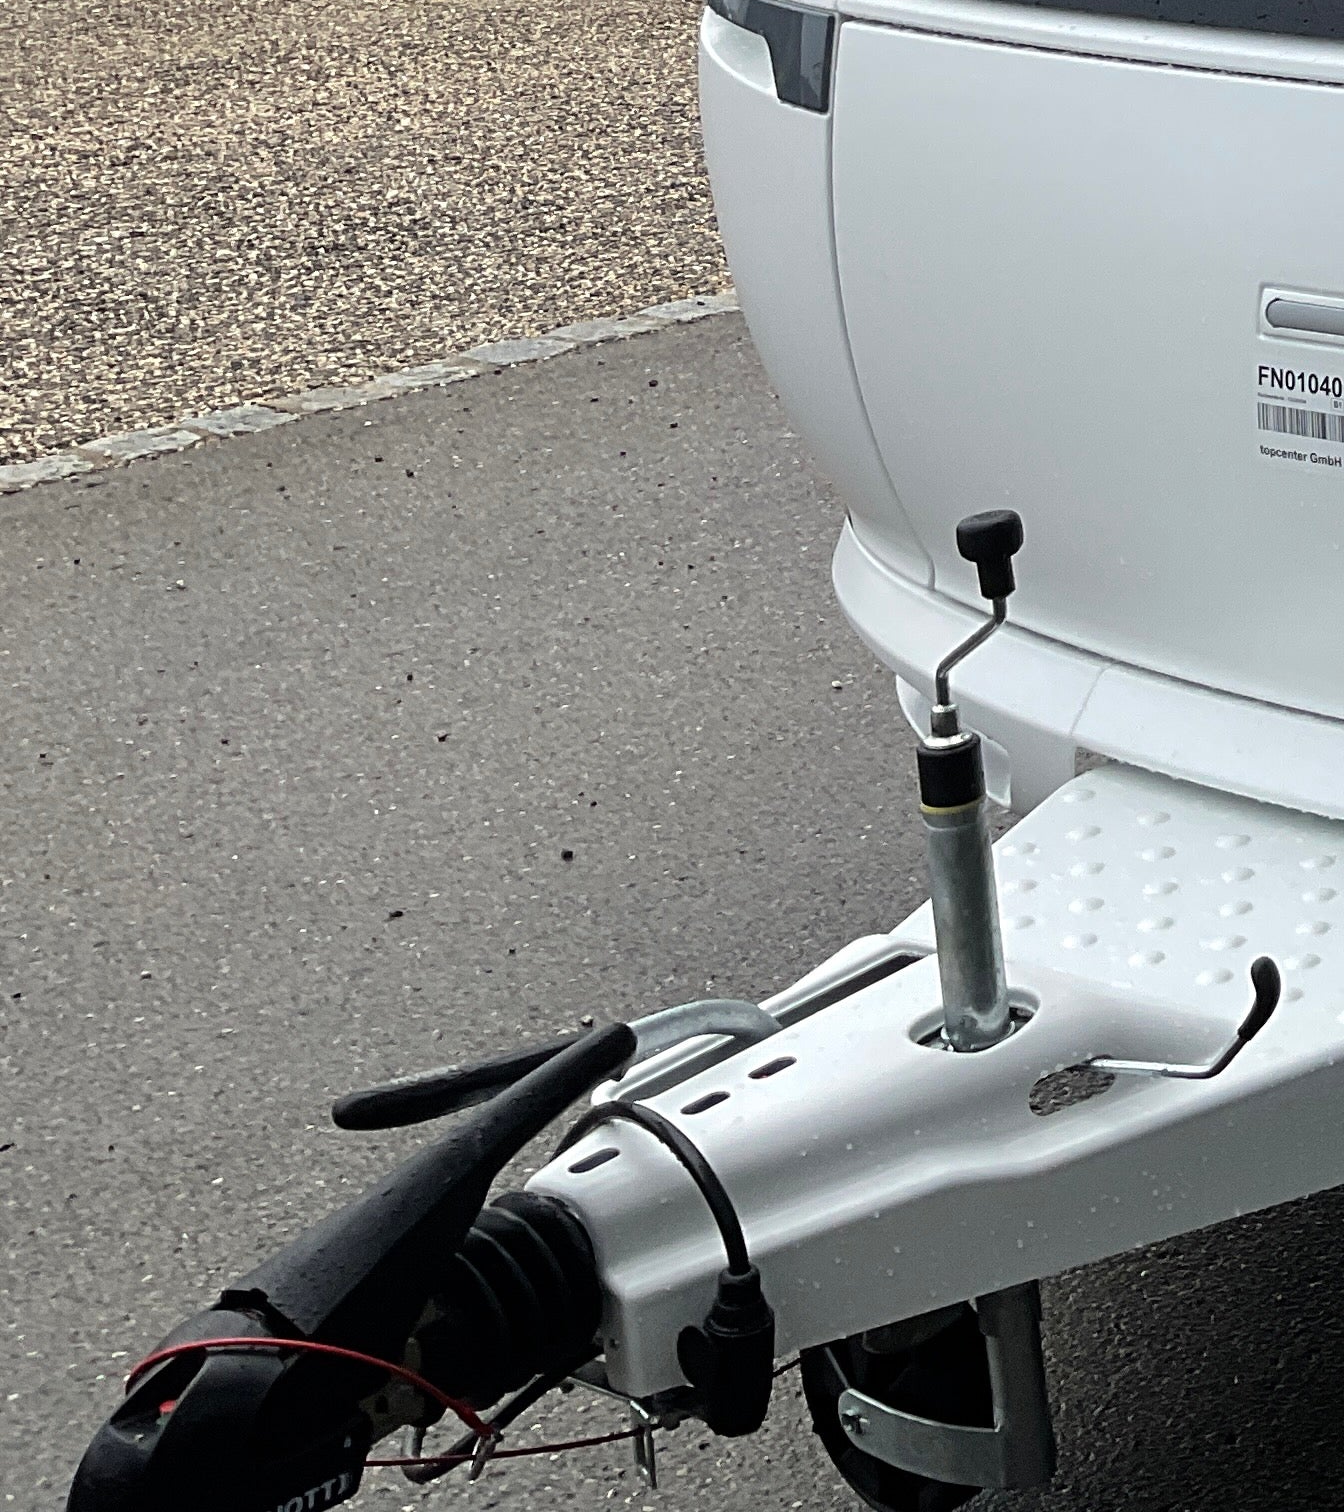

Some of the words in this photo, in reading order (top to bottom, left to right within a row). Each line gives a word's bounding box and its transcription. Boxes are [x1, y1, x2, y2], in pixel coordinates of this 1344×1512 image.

[1257, 365, 1343, 398] FN01040
[1259, 445, 1308, 462] topcenter
[1309, 452, 1342, 468] GmbH
